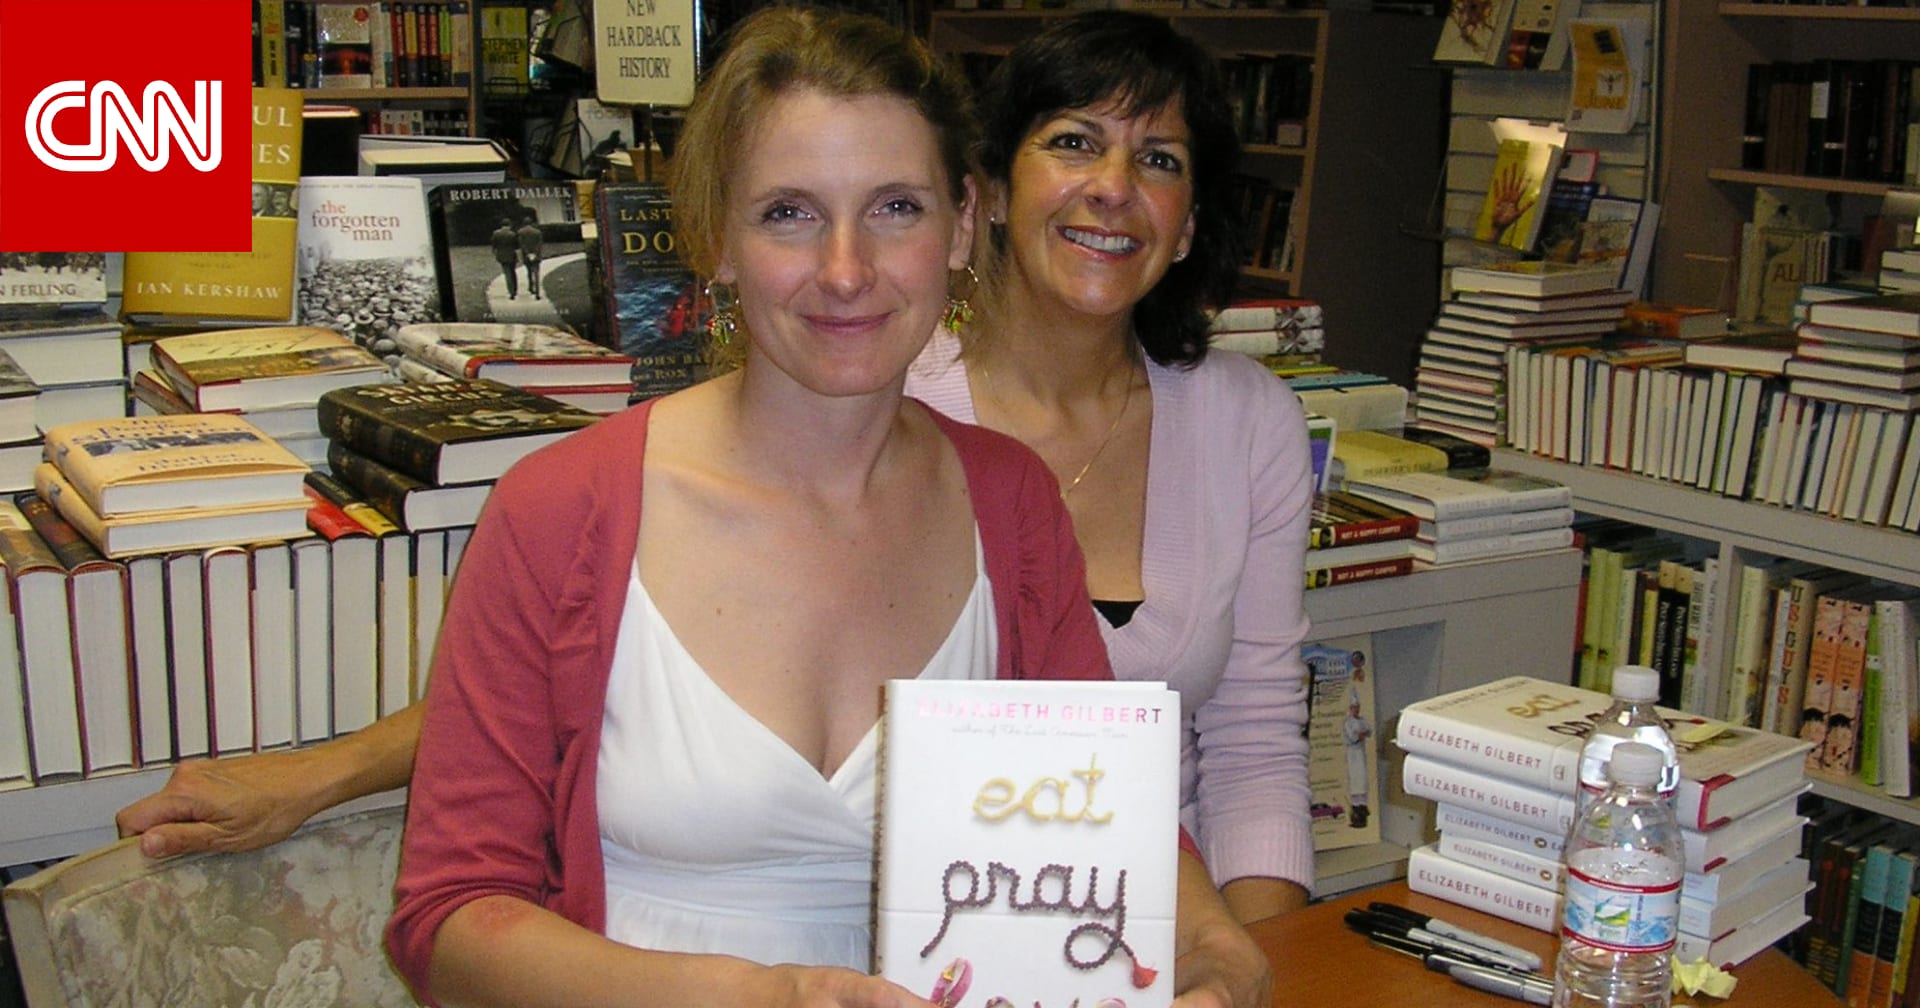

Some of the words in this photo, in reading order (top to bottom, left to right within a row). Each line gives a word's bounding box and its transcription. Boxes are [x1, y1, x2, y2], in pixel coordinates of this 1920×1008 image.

[626, 0, 656, 17] NEW
[607, 26, 682, 47] HARDBACK
[489, 51, 519, 64] WHITE
[620, 57, 671, 78] HISTORY
[450, 187, 510, 201] ROBERT
[515, 186, 572, 200] DALLEK
[320, 200, 346, 214] the
[620, 208, 673, 222] LAST
[312, 211, 400, 232] forgotten
[352, 226, 394, 241] man
[11, 283, 77, 297] FERLING
[136, 281, 174, 294] IAN
[184, 283, 283, 298] KERSHAW
[636, 354, 677, 367] JOHN
[389, 390, 502, 405] CIRCUS
[1341, 530, 1352, 539] NOT
[1360, 528, 1378, 537] HAPPY
[1378, 526, 1401, 535] CAMPER
[1337, 572, 1349, 580] NOT
[1356, 567, 1374, 577] HAPPY
[1375, 565, 1397, 575] CAMPER
[918, 699, 1050, 718] ELIZABETH
[1062, 704, 1162, 723] GILBERT
[1409, 725, 1479, 752] ELIZABETH
[1485, 746, 1542, 769] GILBERT
[971, 752, 1115, 825] eat
[1415, 774, 1485, 801] ELIZABETH
[1490, 794, 1548, 819] GILBERT
[1444, 814, 1491, 833] ELIZABETH
[1493, 826, 1531, 842] GILBERT
[1453, 843, 1499, 864] ELIZABETH
[1500, 857, 1538, 875] GILBERT
[1419, 869, 1489, 899] ELIZABETH
[1494, 892, 1551, 918] GILBERT
[920, 860, 1128, 970] pray
